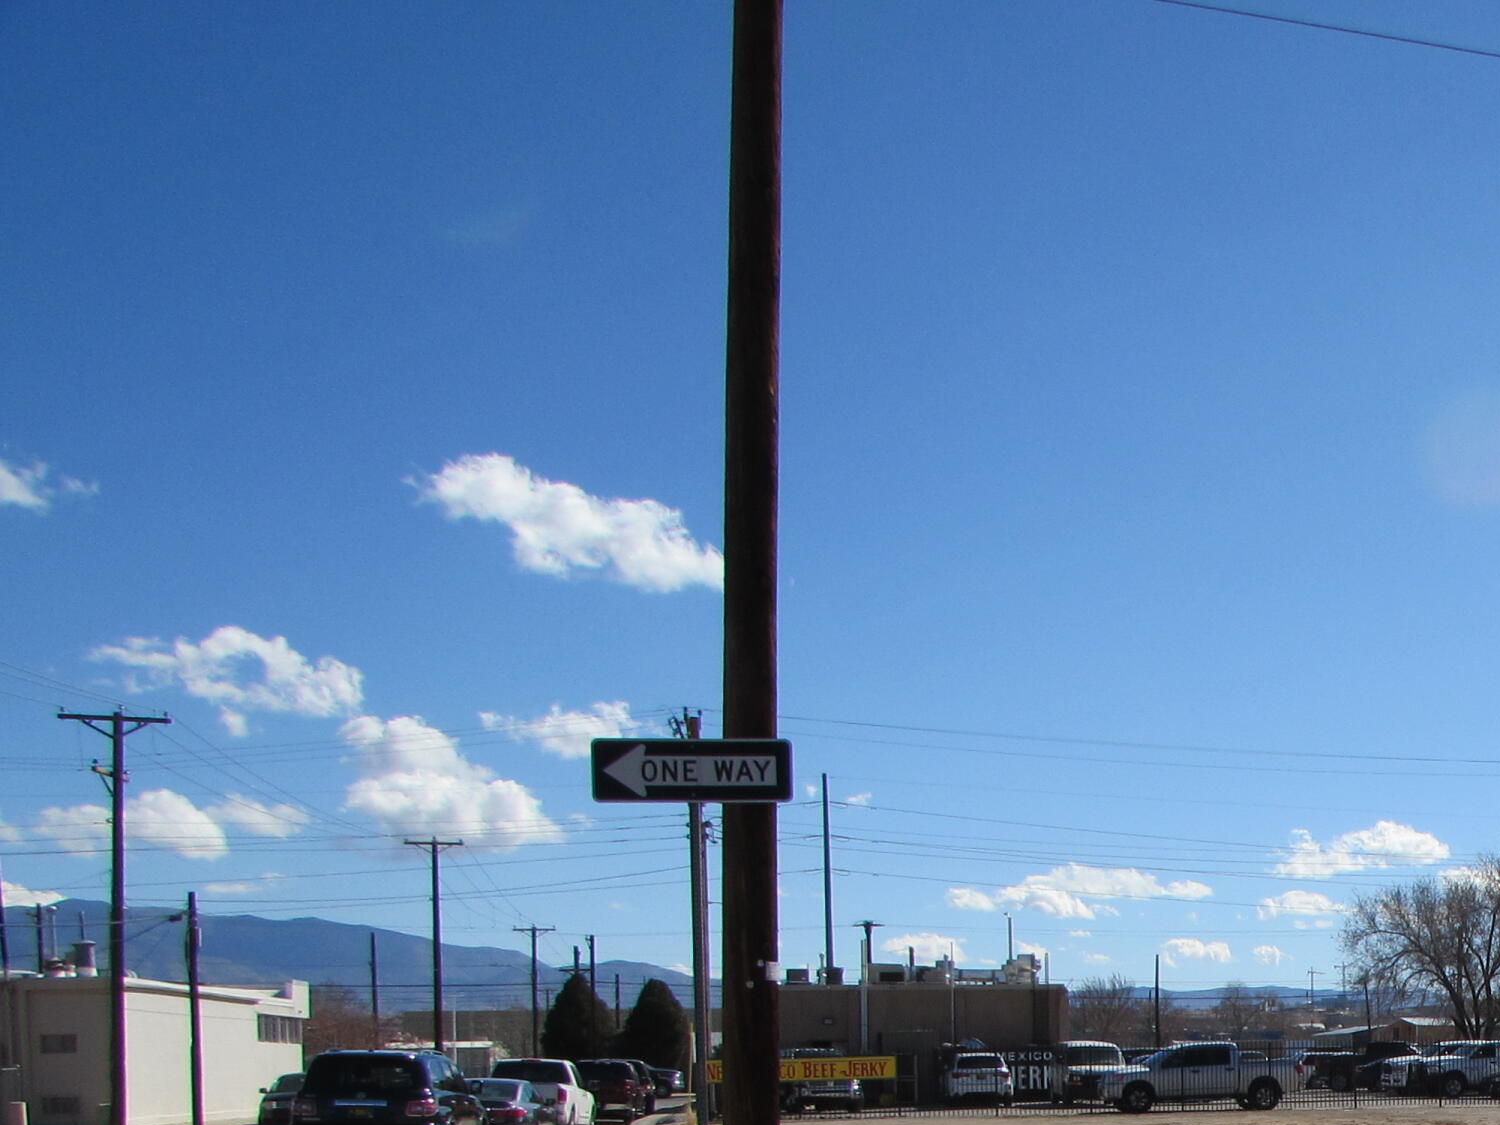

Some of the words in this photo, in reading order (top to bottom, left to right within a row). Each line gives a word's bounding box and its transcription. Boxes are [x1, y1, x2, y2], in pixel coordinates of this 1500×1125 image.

[641, 759, 698, 782] ONE
[714, 759, 771, 782] WAY
[706, 1063, 723, 1081] NE
[801, 1061, 838, 1078] BEEF
[840, 1060, 888, 1077] JERKY
